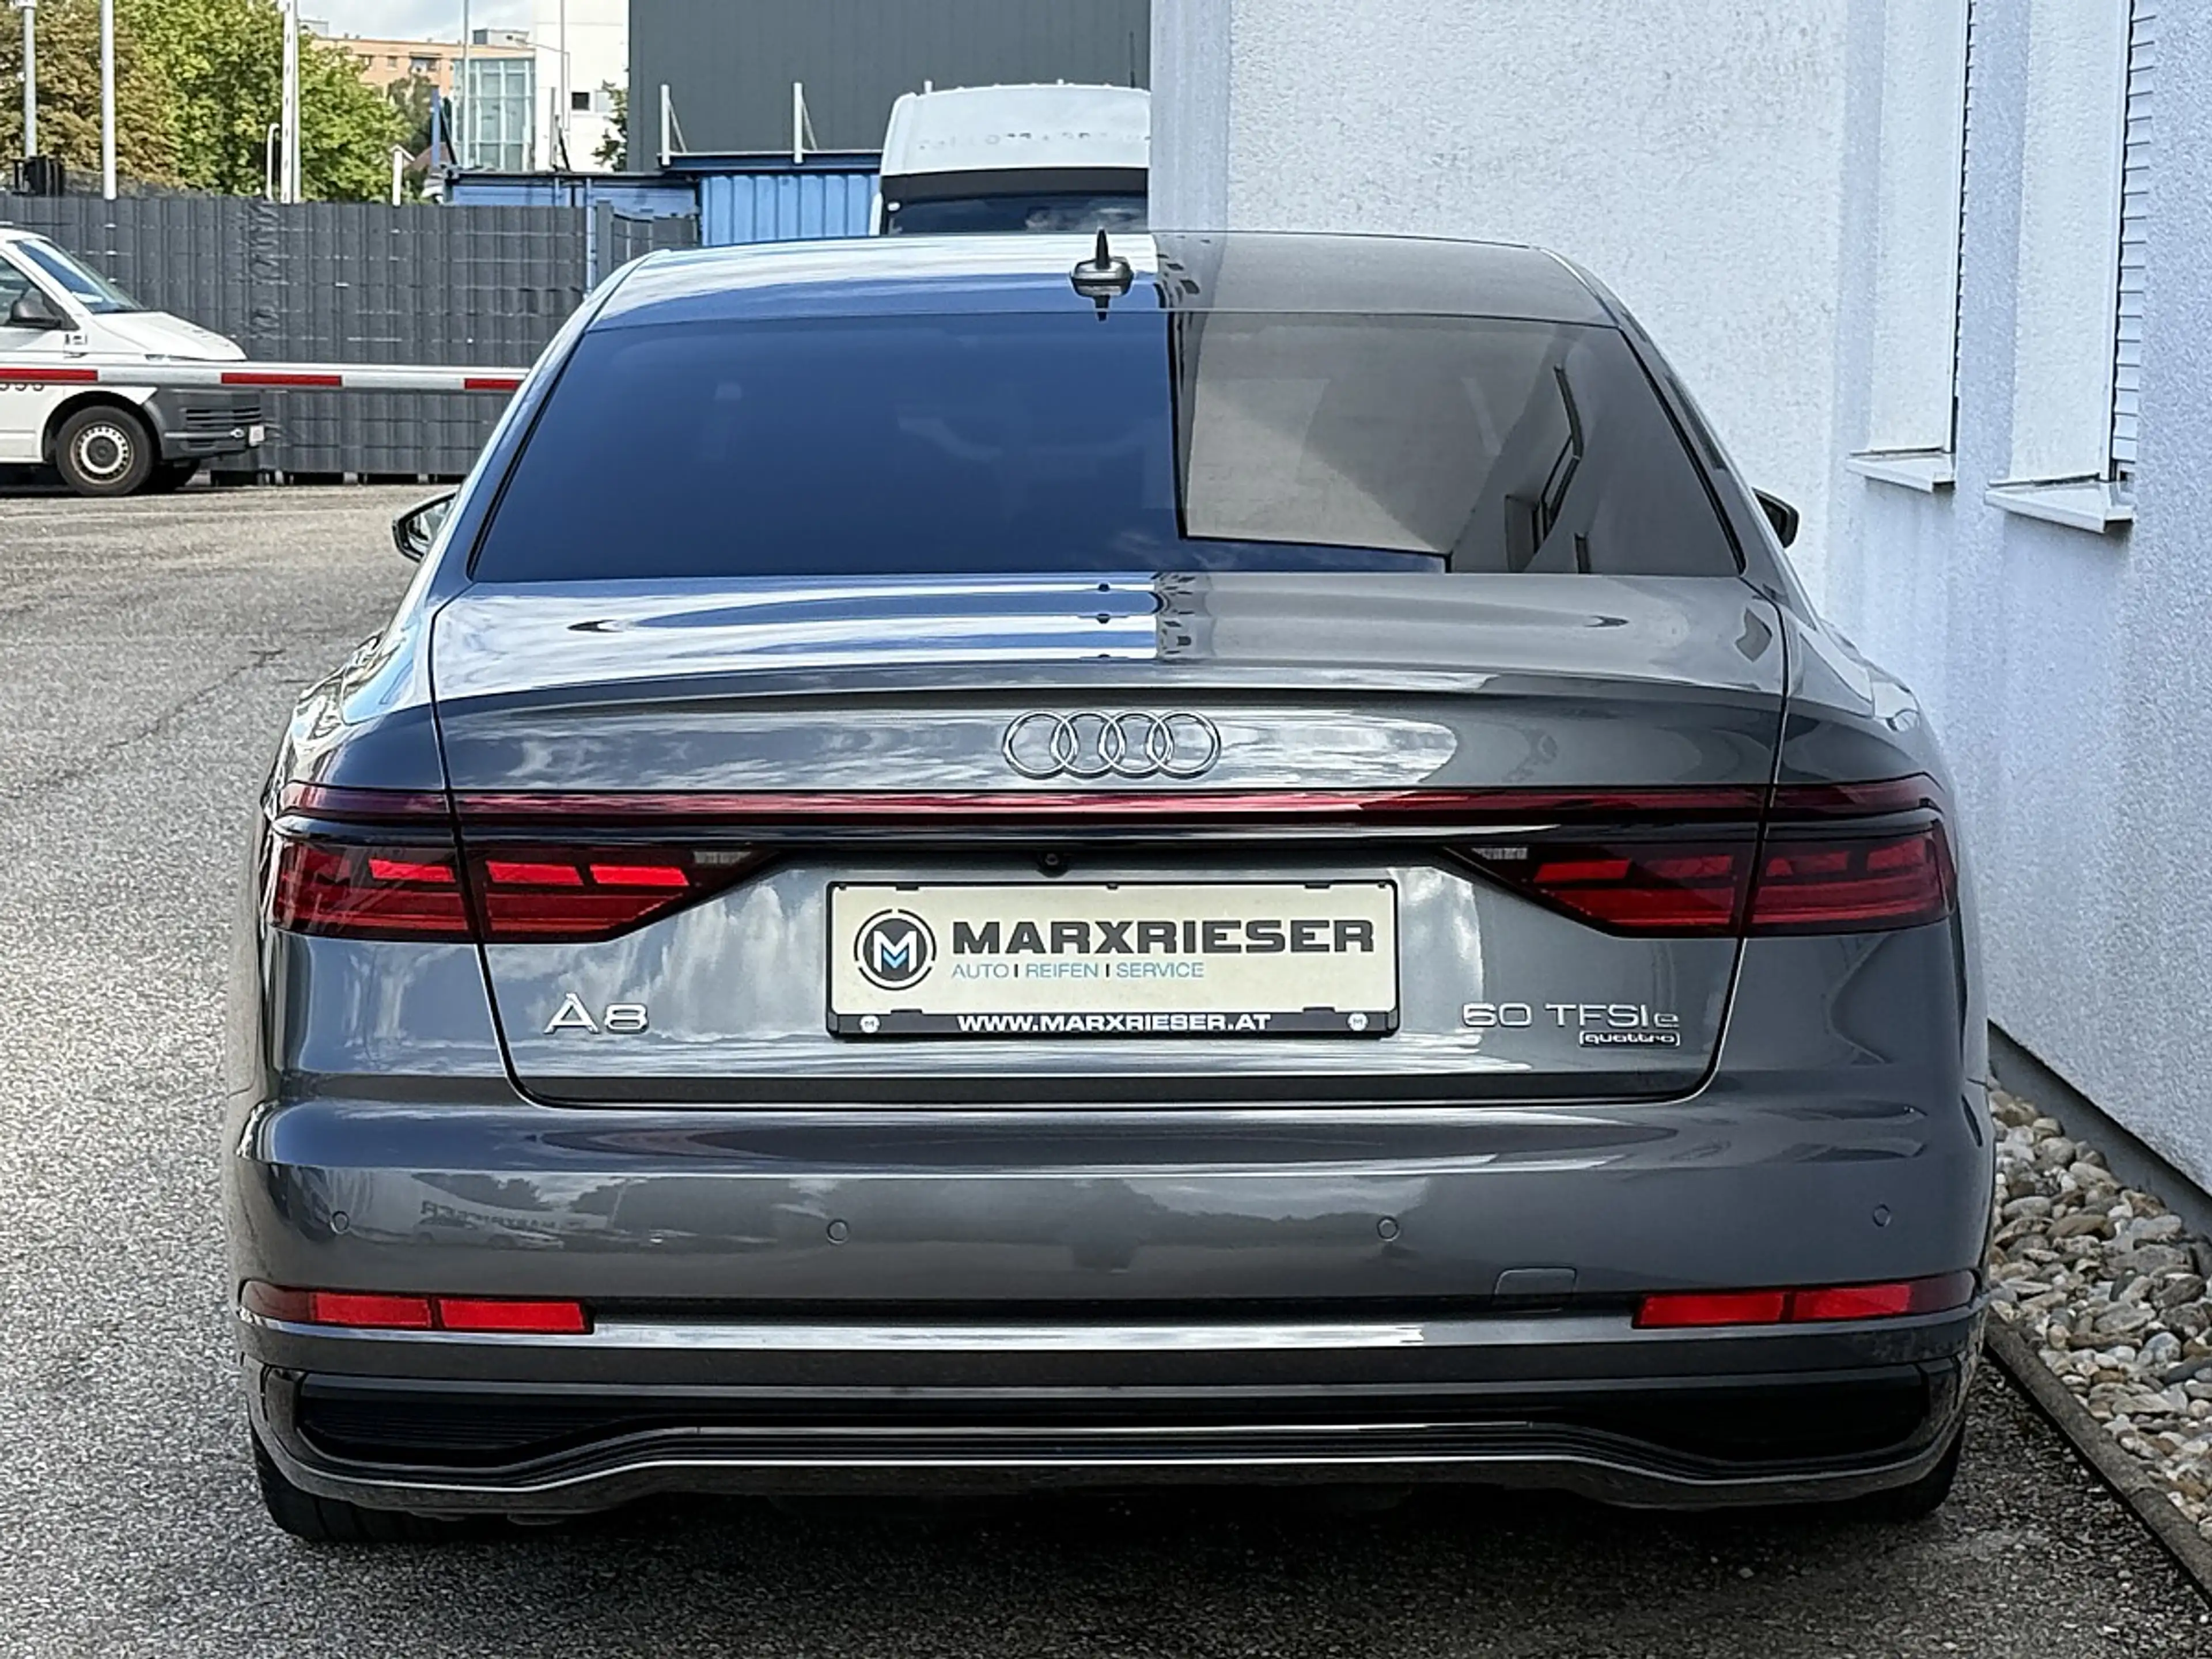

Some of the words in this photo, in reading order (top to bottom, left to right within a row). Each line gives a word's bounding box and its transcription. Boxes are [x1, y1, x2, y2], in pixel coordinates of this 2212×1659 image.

[952, 920, 1373, 954] MARXRIESER
[952, 964, 1009, 978] AUTO
[1026, 963, 1099, 978] REIFEN
[1116, 963, 1203, 978] SERVICE
[543, 993, 649, 1034] A8
[957, 1014, 1271, 1031] WWW.MARXRIESER.AT
[1463, 1003, 1532, 1027] 60
[1585, 1033, 1675, 1046] quattro
